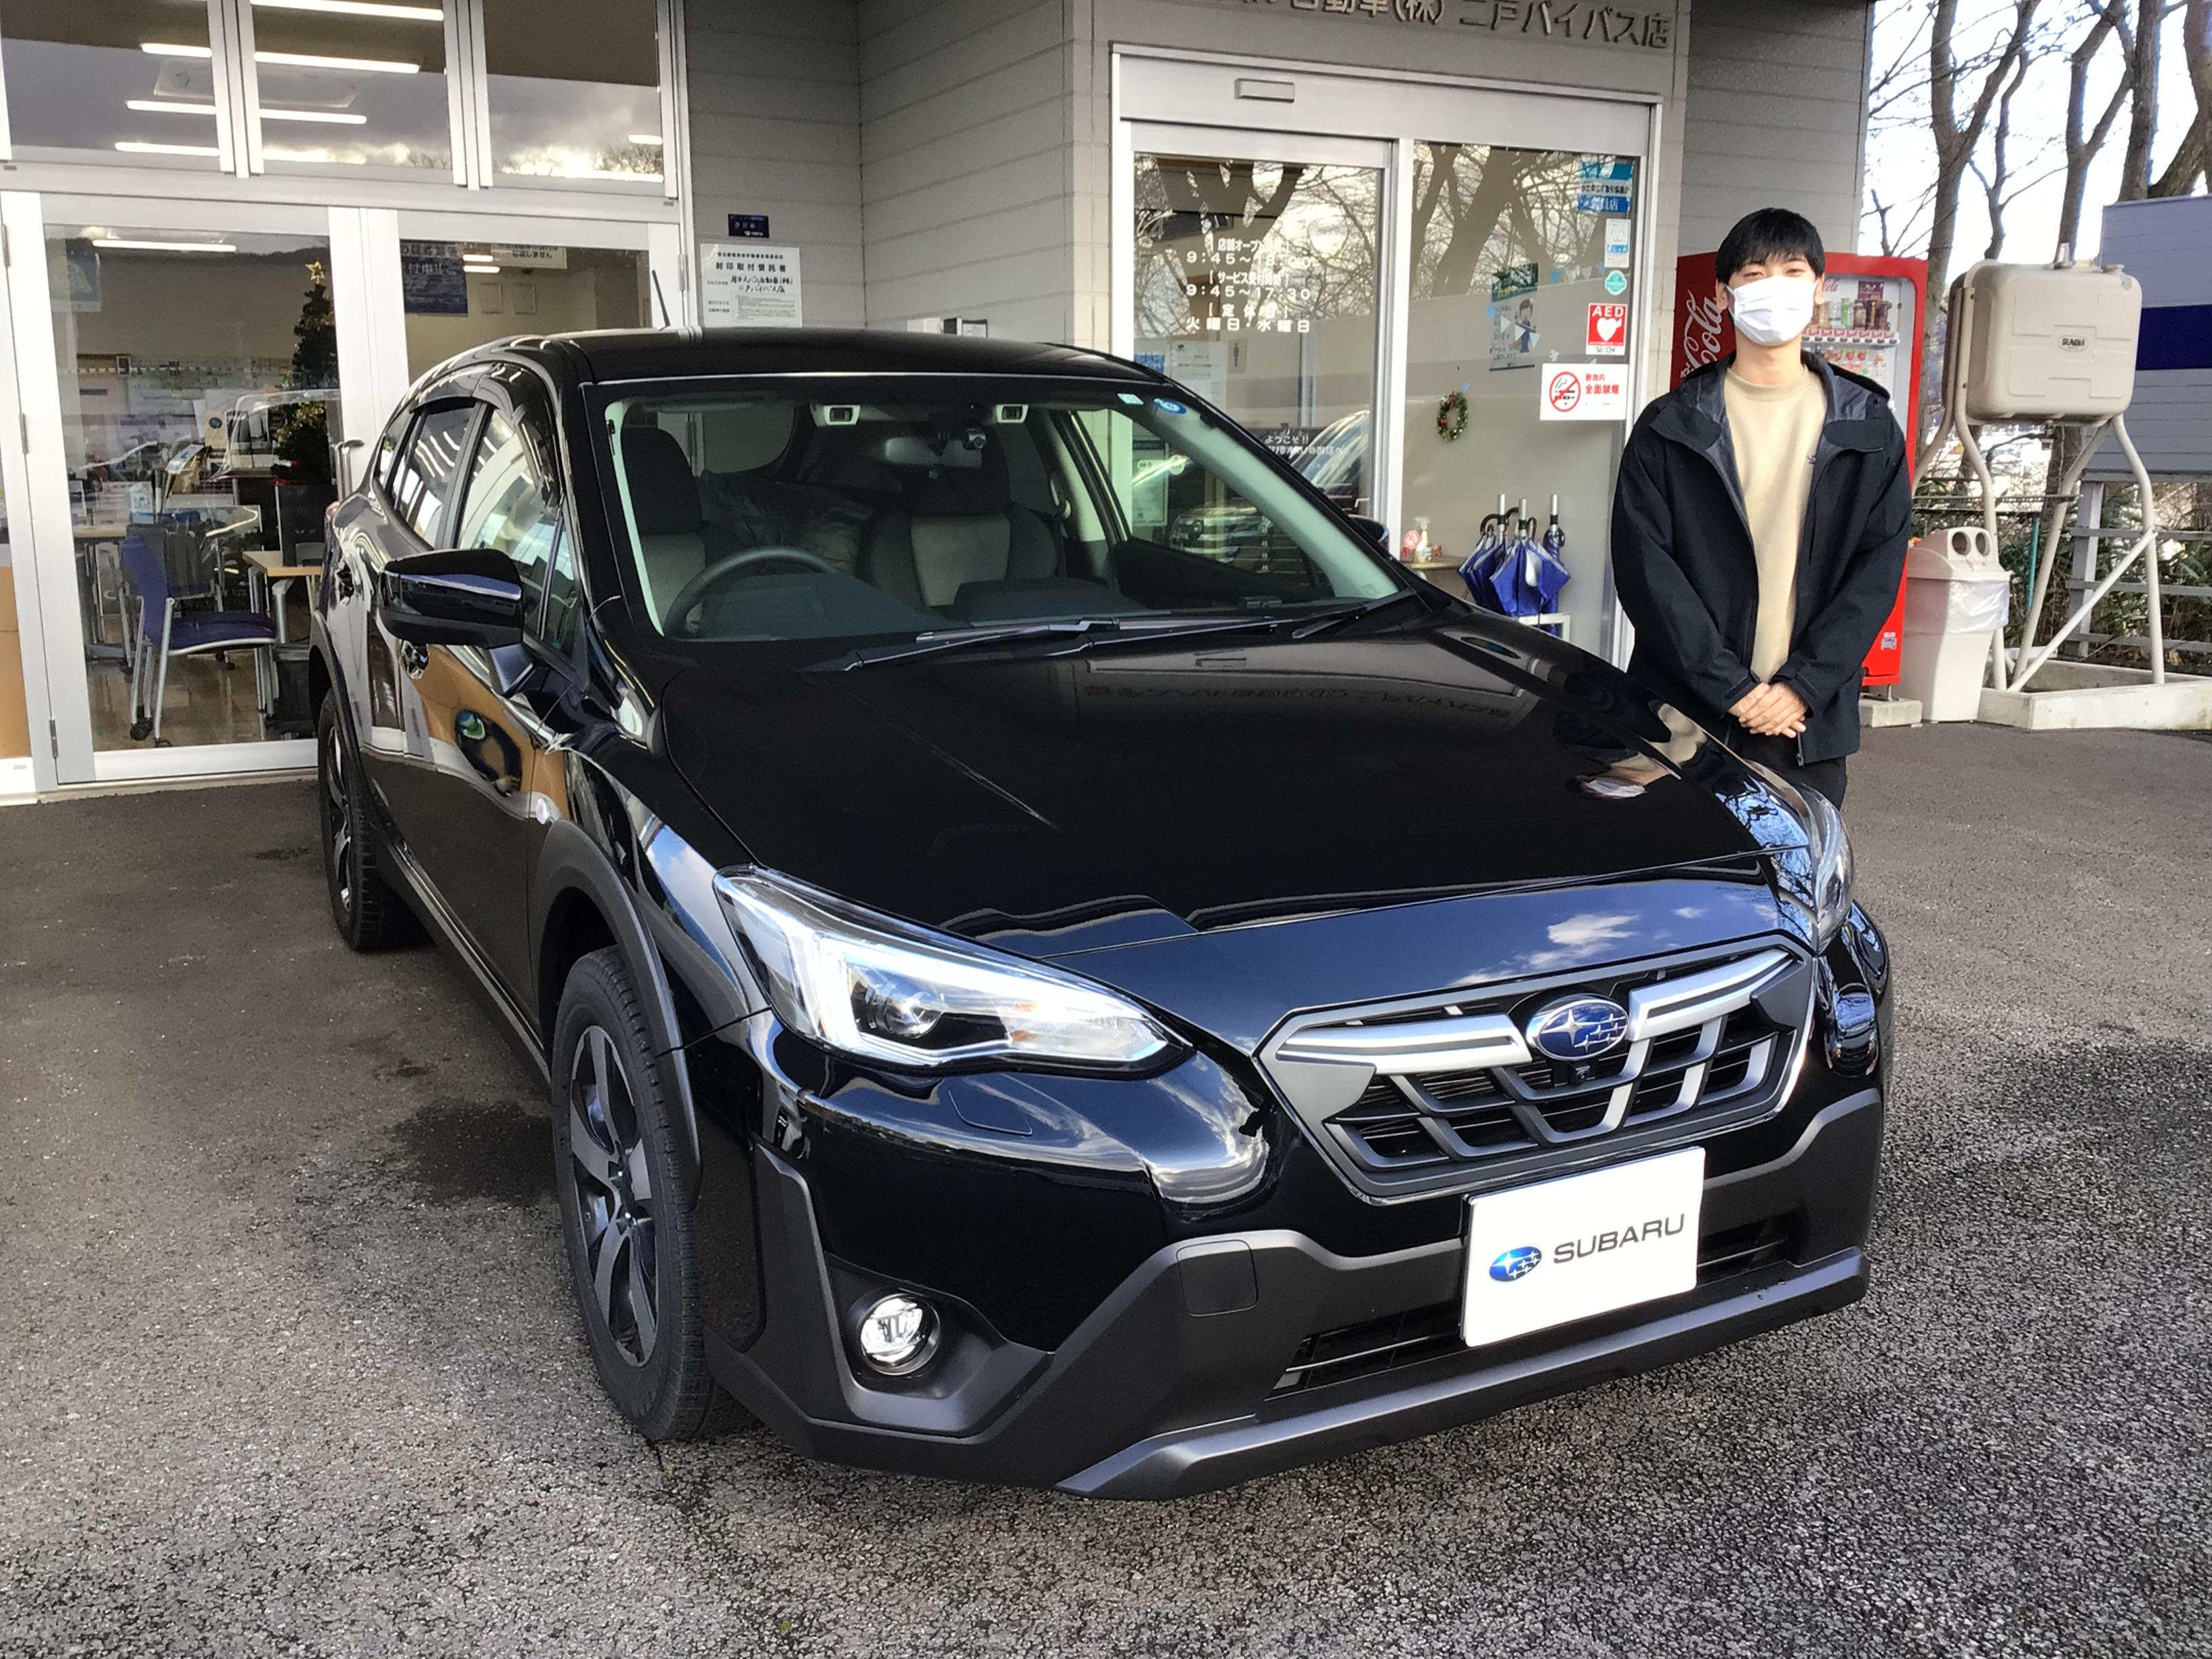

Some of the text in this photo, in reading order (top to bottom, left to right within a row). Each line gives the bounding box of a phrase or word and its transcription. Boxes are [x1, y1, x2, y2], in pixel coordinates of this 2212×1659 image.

[1458, 0, 1669, 49] 二戸バイパス店
[1591, 305, 1624, 318] AED
[1185, 316, 1310, 333] 火曜日・水曜日
[1585, 384, 1620, 394] 全面禁煙
[1553, 1213, 1685, 1264] SUBARU
